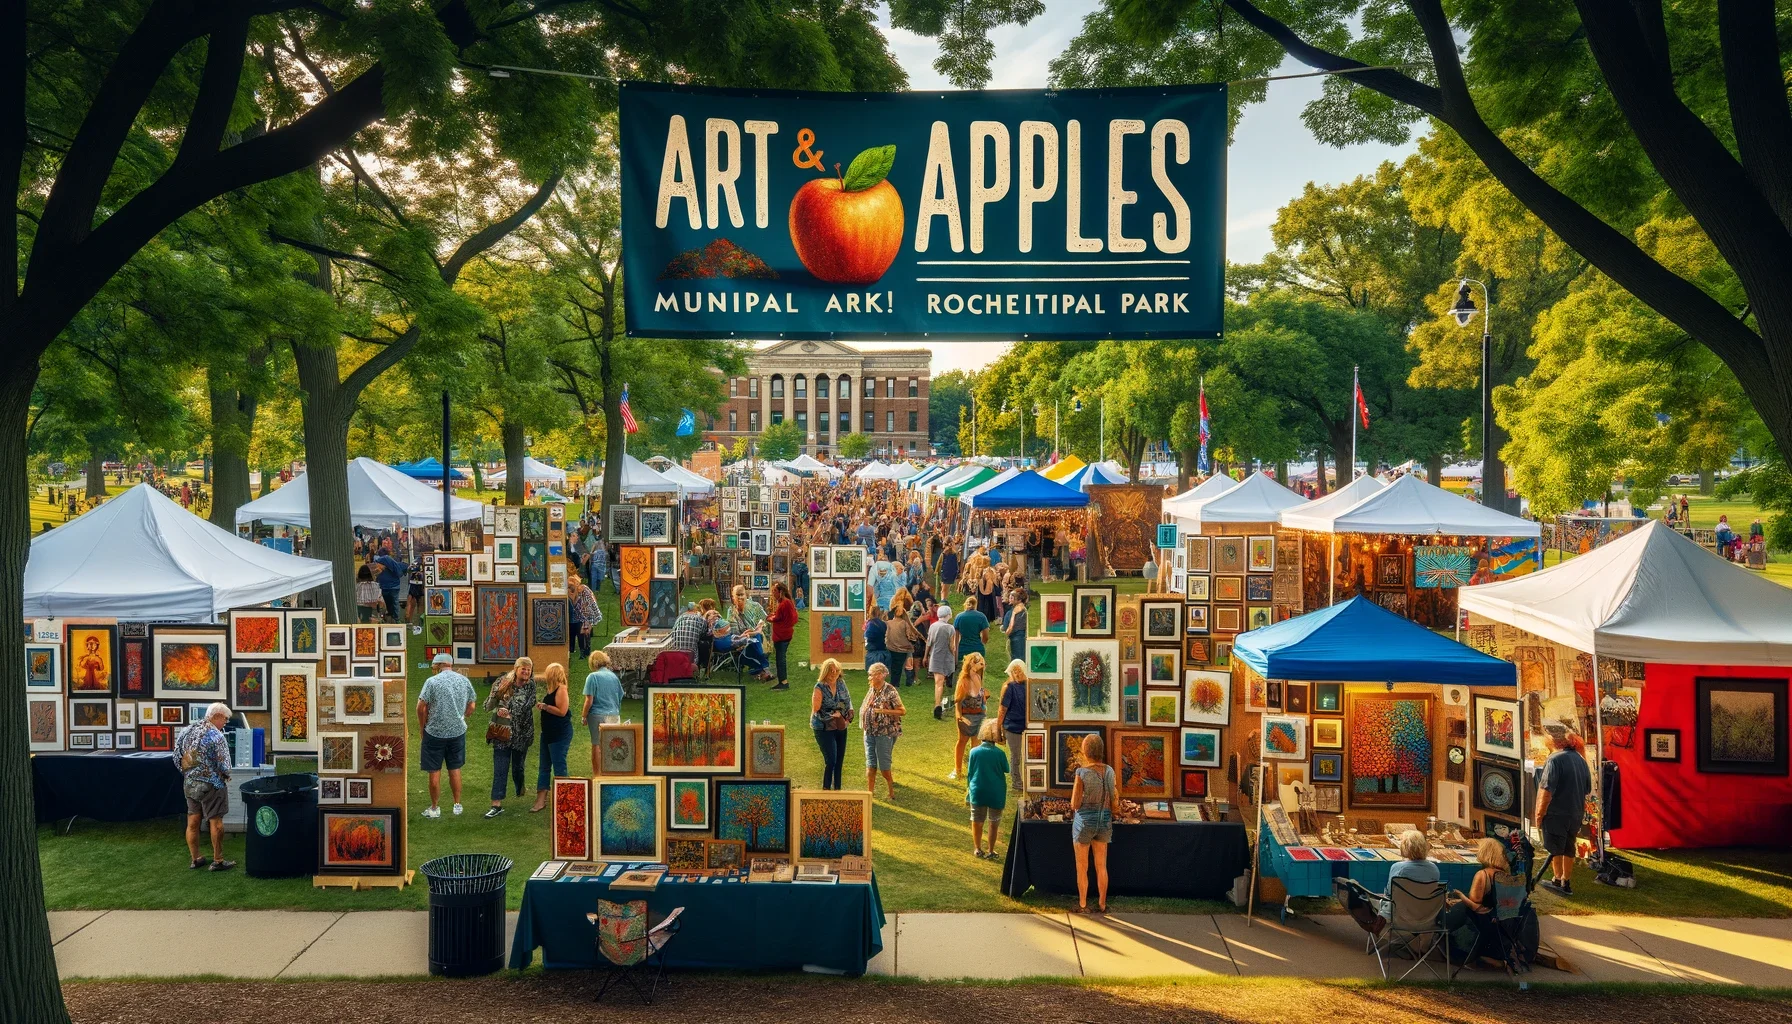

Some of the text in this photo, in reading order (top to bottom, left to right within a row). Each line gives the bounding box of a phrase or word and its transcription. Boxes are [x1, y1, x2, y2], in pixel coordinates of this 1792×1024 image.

[656, 115, 1191, 253] ART & APPLES
[654, 291, 893, 313] MUNIPAL ARK!
[927, 293, 1189, 314] ROCHEITIPAL PARK
